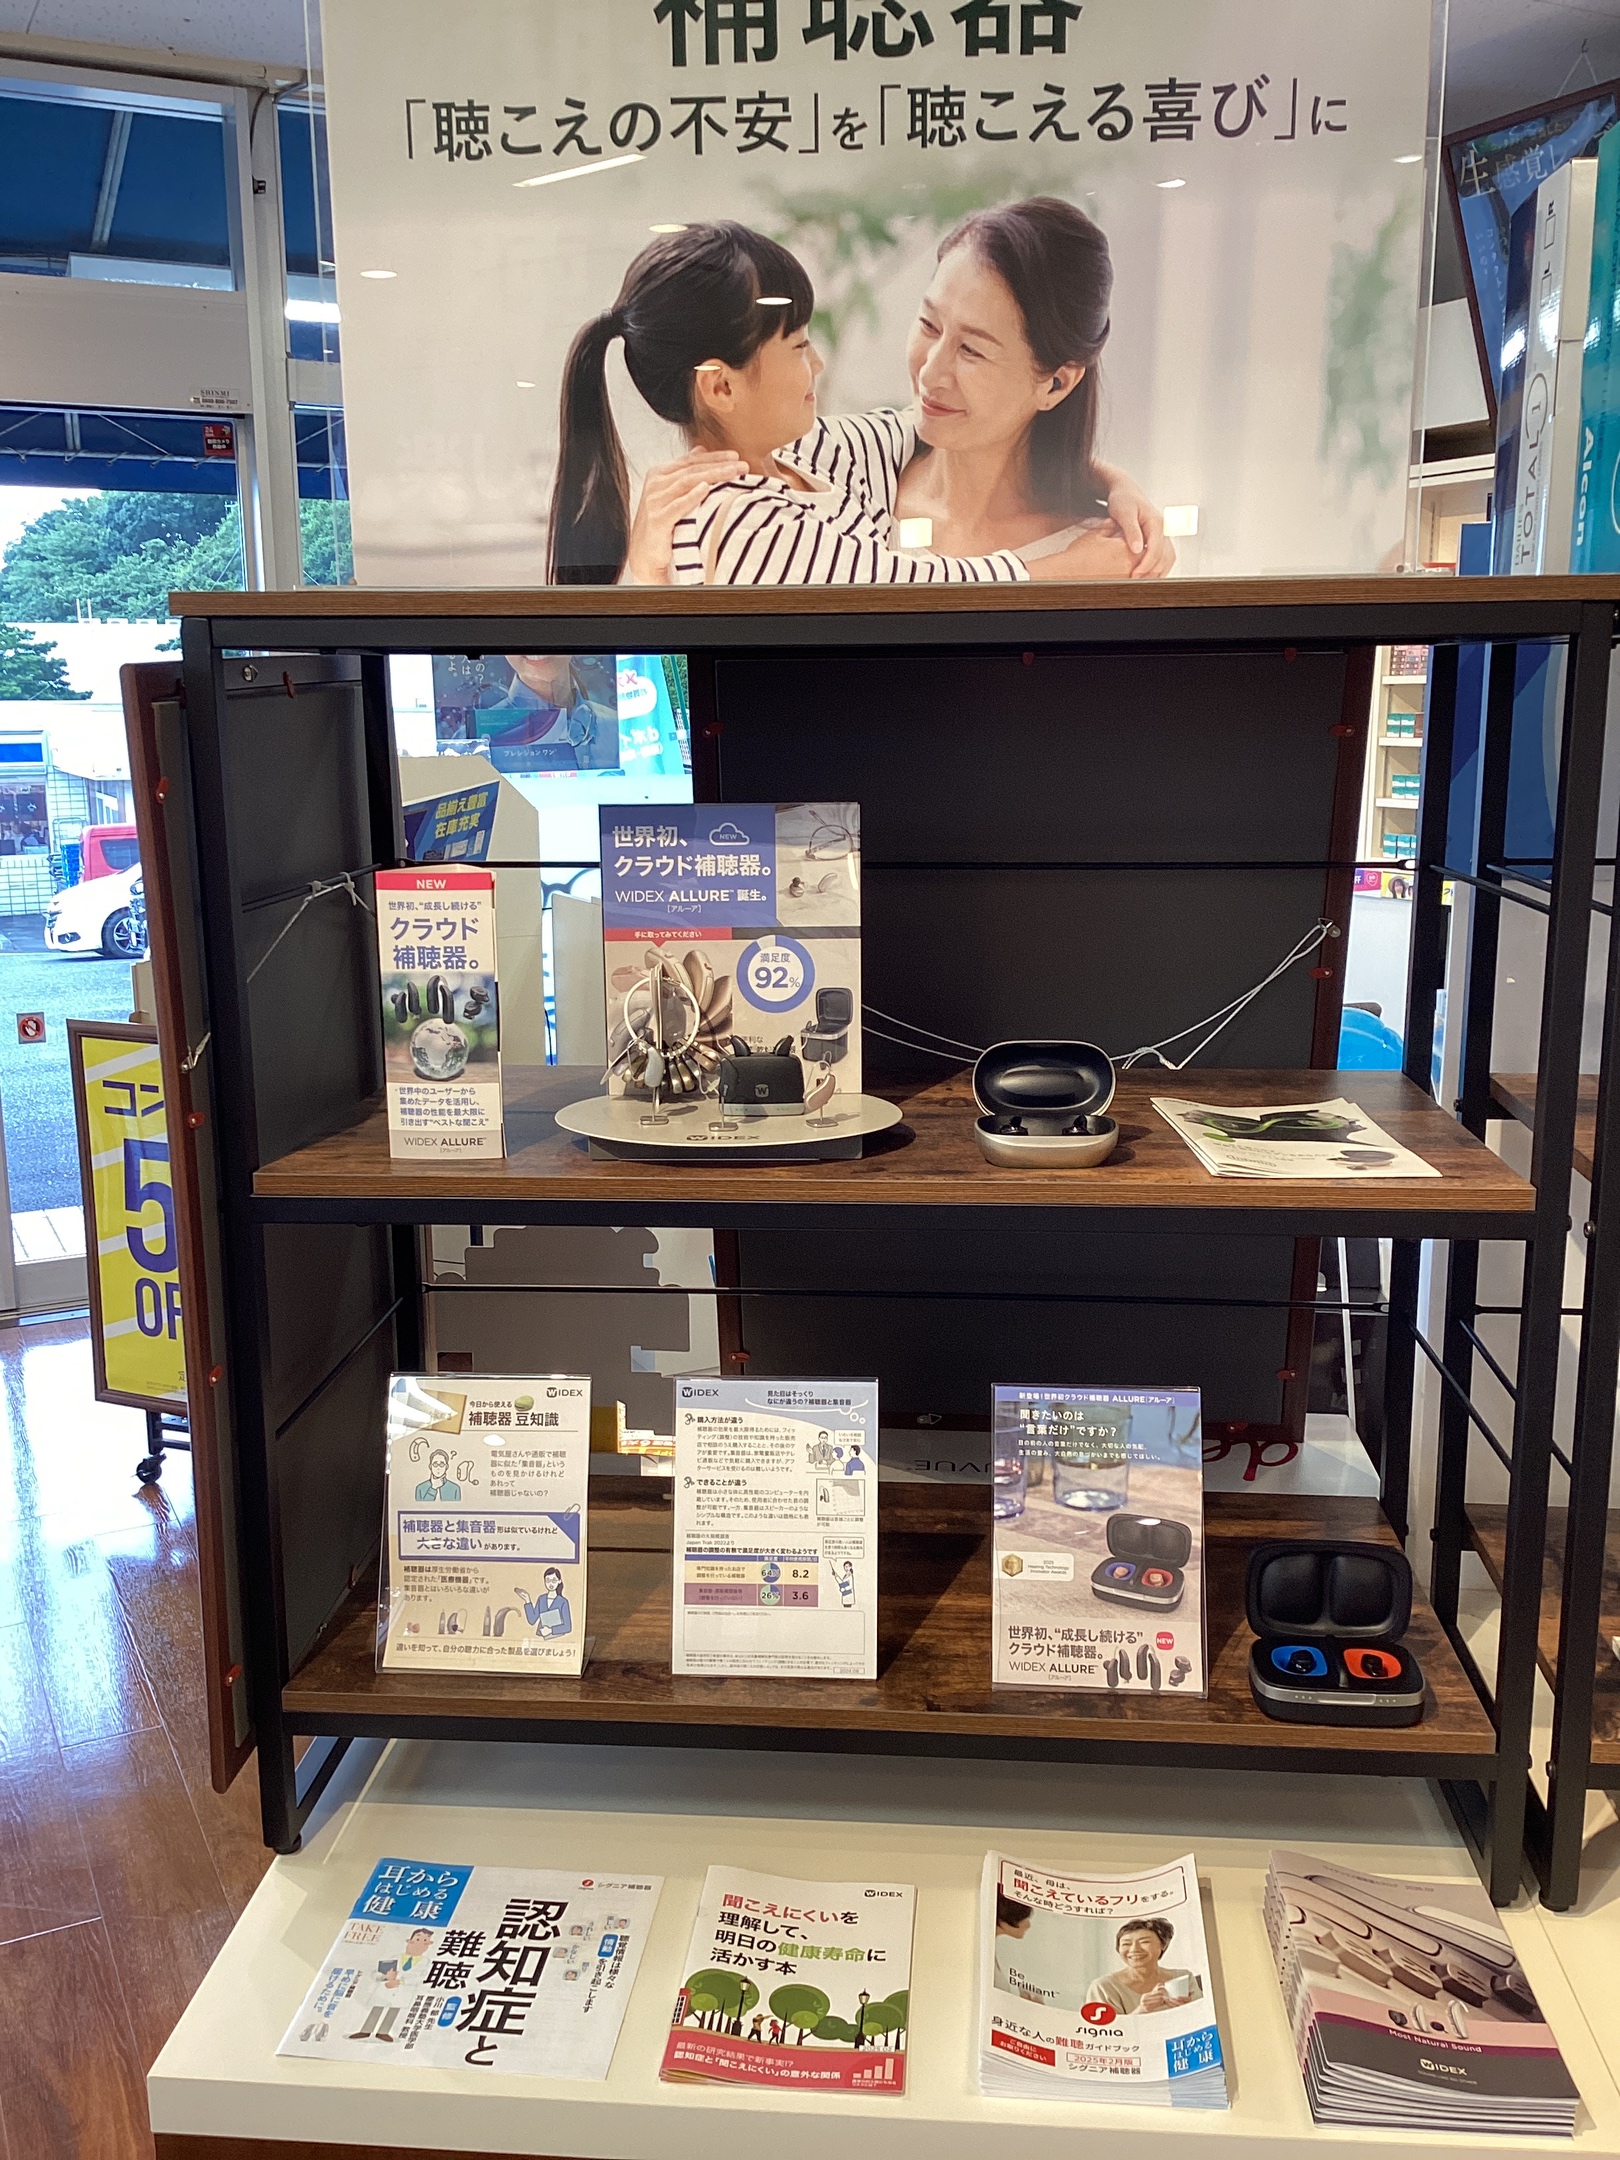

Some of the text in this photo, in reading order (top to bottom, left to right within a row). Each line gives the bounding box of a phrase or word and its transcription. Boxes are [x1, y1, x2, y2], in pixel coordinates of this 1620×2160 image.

[405, 76, 1349, 162] 「聴こえの不安」を「聴こえる喜び」に
[1576, 426, 1595, 547] Alcon
[1521, 429, 1541, 565] TOTAL
[434, 791, 489, 820] 品揃え豊富
[434, 812, 482, 839] 在庫充実
[612, 825, 688, 849] 世界初、
[614, 854, 772, 877] クラウド補聴器。
[416, 879, 447, 889] NEW
[615, 890, 665, 903] WIDEX
[737, 889, 767, 901] 誕生。
[388, 900, 482, 911] 世界初、“成長し続ける”
[390, 917, 479, 941] クラウド
[634, 930, 702, 939] 手に取ってみてください
[393, 945, 479, 970] 補聴器。
[760, 953, 791, 964] 満足度
[399, 1087, 476, 1096] 世界中のユーザーから
[399, 1097, 480, 1106] 集めたデータを活用し、
[400, 1107, 486, 1116] 補聴器の性能を最大限に
[404, 1137, 438, 1146] WIDEX
[546, 1386, 583, 1398] WIDEX
[682, 1386, 719, 1398] WIDEX
[469, 1400, 513, 1409] 今日から使える
[468, 1412, 559, 1427] 補聴器 豆知識
[697, 1416, 743, 1424] 購入方法が違う
[1019, 1409, 1084, 1421] 聞きたいのは
[490, 1470, 565, 1478] ものを見かけるけれど
[490, 1480, 515, 1488] あれって
[697, 1479, 747, 1487] できることが違う
[403, 1519, 558, 1535] 補聴器と集音器 形は似ているけれど
[484, 1542, 521, 1551] があります。
[403, 1565, 479, 1574] 補聴器は厚生労働省から
[792, 1569, 809, 1579] 8.2
[403, 1585, 490, 1594] 集音器とはいろいろな違いが
[761, 1591, 809, 1600] 26% 3.6
[1008, 1625, 1143, 1644] 世界初、“成長し続ける”
[1157, 1637, 1174, 1645] NEW
[1009, 1642, 1103, 1660] クラウド補聴器。
[1009, 1661, 1046, 1672] WIDEX
[378, 1865, 459, 1888] 耳から
[374, 1882, 448, 1900] はじめる
[864, 1889, 903, 1898] WIDEX
[1013, 1877, 1174, 1906] 聞こえているフリをする。
[722, 1893, 860, 1925] 聞こえにくいを
[1013, 1890, 1114, 1915] そんな時どうすれば?
[350, 1923, 385, 1933] TAKE
[718, 1911, 809, 1940] 理解して、
[343, 1932, 382, 1942] FREE
[714, 1930, 887, 1962] 明日の健康寿命に
[423, 1929, 486, 1990] 難聴
[709, 1947, 797, 1976] 活かす本
[1009, 1966, 1025, 1980] Be
[455, 1898, 569, 2067] 認知症と
[991, 2015, 1140, 2053] 身近な人の難聴ガイドブック
[1075, 2026, 1123, 2038] signia
[1172, 2031, 1214, 2053] 耳から
[1389, 2028, 1483, 2053] Most Natural Sound
[1173, 2040, 1213, 2061] はじめる
[673, 2051, 841, 2080] 認知症と「聞こえにくい」の意外な関係
[1074, 2054, 1134, 2066] 2025年2月版
[1420, 2058, 1468, 2076] WIDEX
[1068, 2063, 1141, 2075] シグニア補聴器
